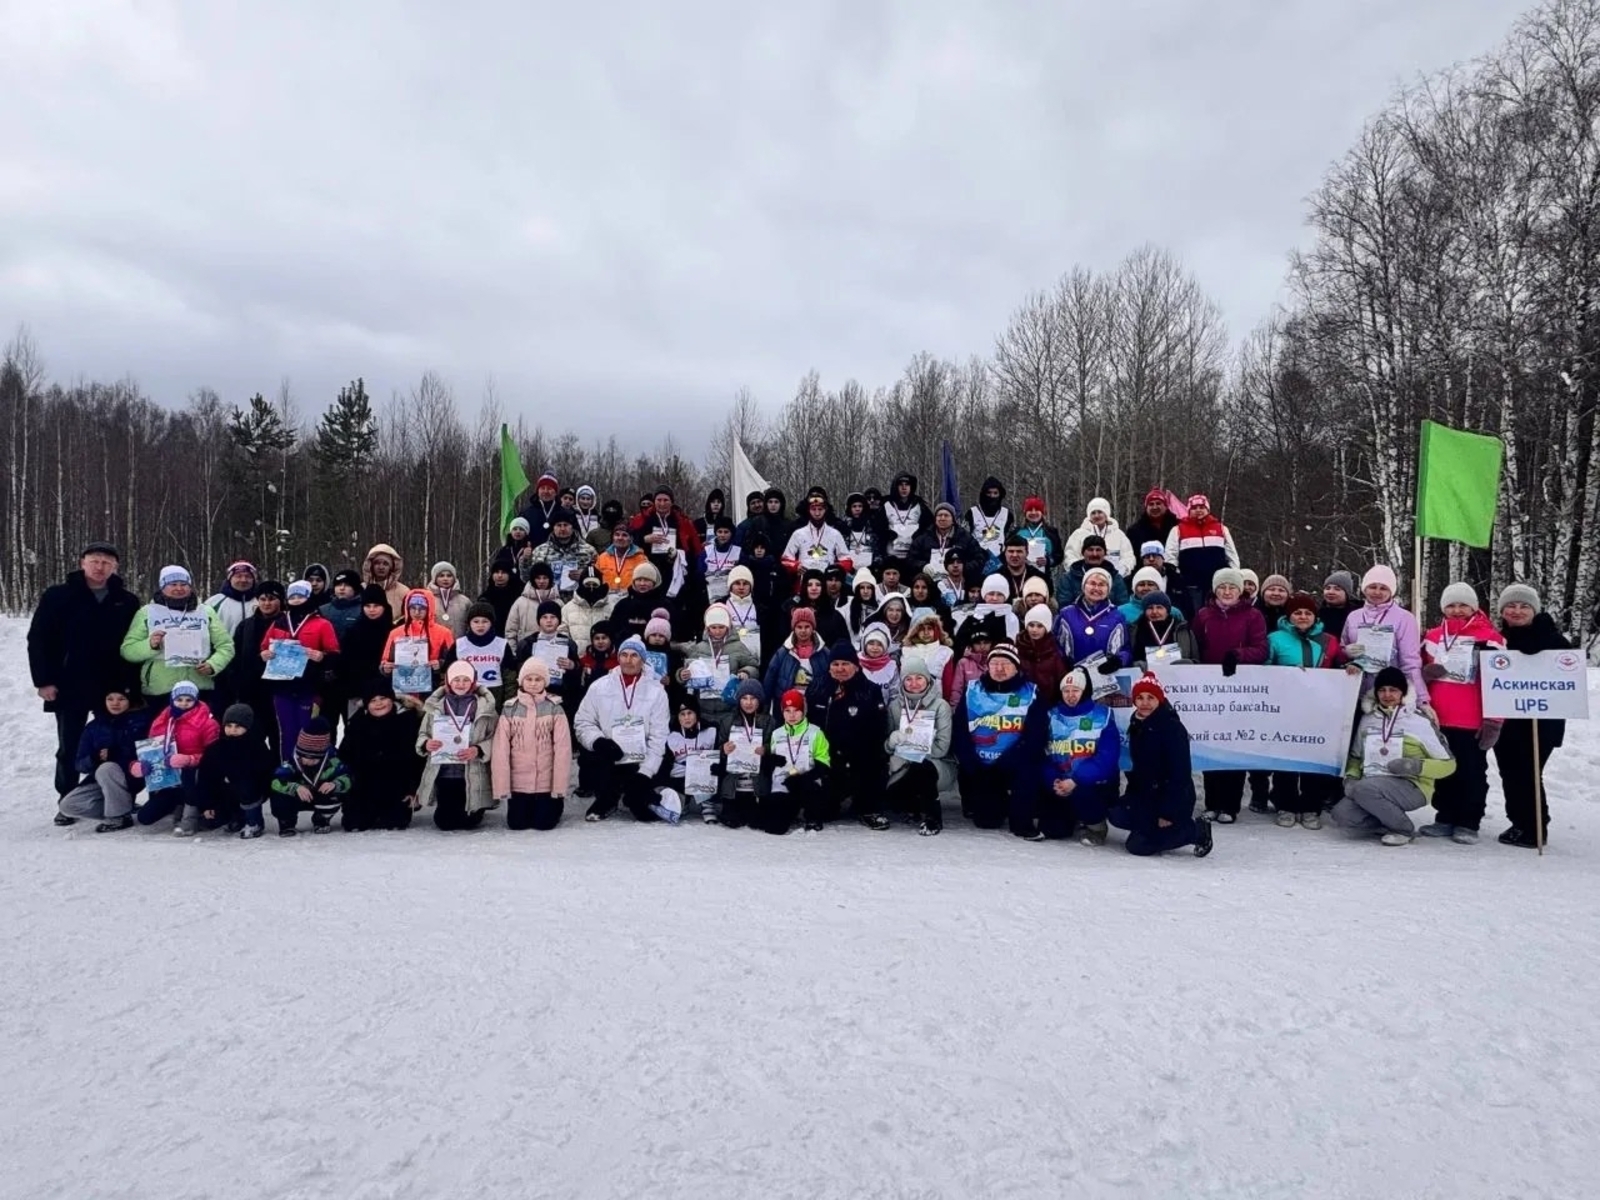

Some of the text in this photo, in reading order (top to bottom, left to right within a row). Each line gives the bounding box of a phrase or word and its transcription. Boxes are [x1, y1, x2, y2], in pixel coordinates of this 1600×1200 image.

[1491, 678, 1576, 691] Аскинская
[1174, 701, 1226, 715] балалар
[1515, 699, 1549, 713] ЦРБ
[1187, 729, 1326, 745] кий сад №2 с.Аскино
